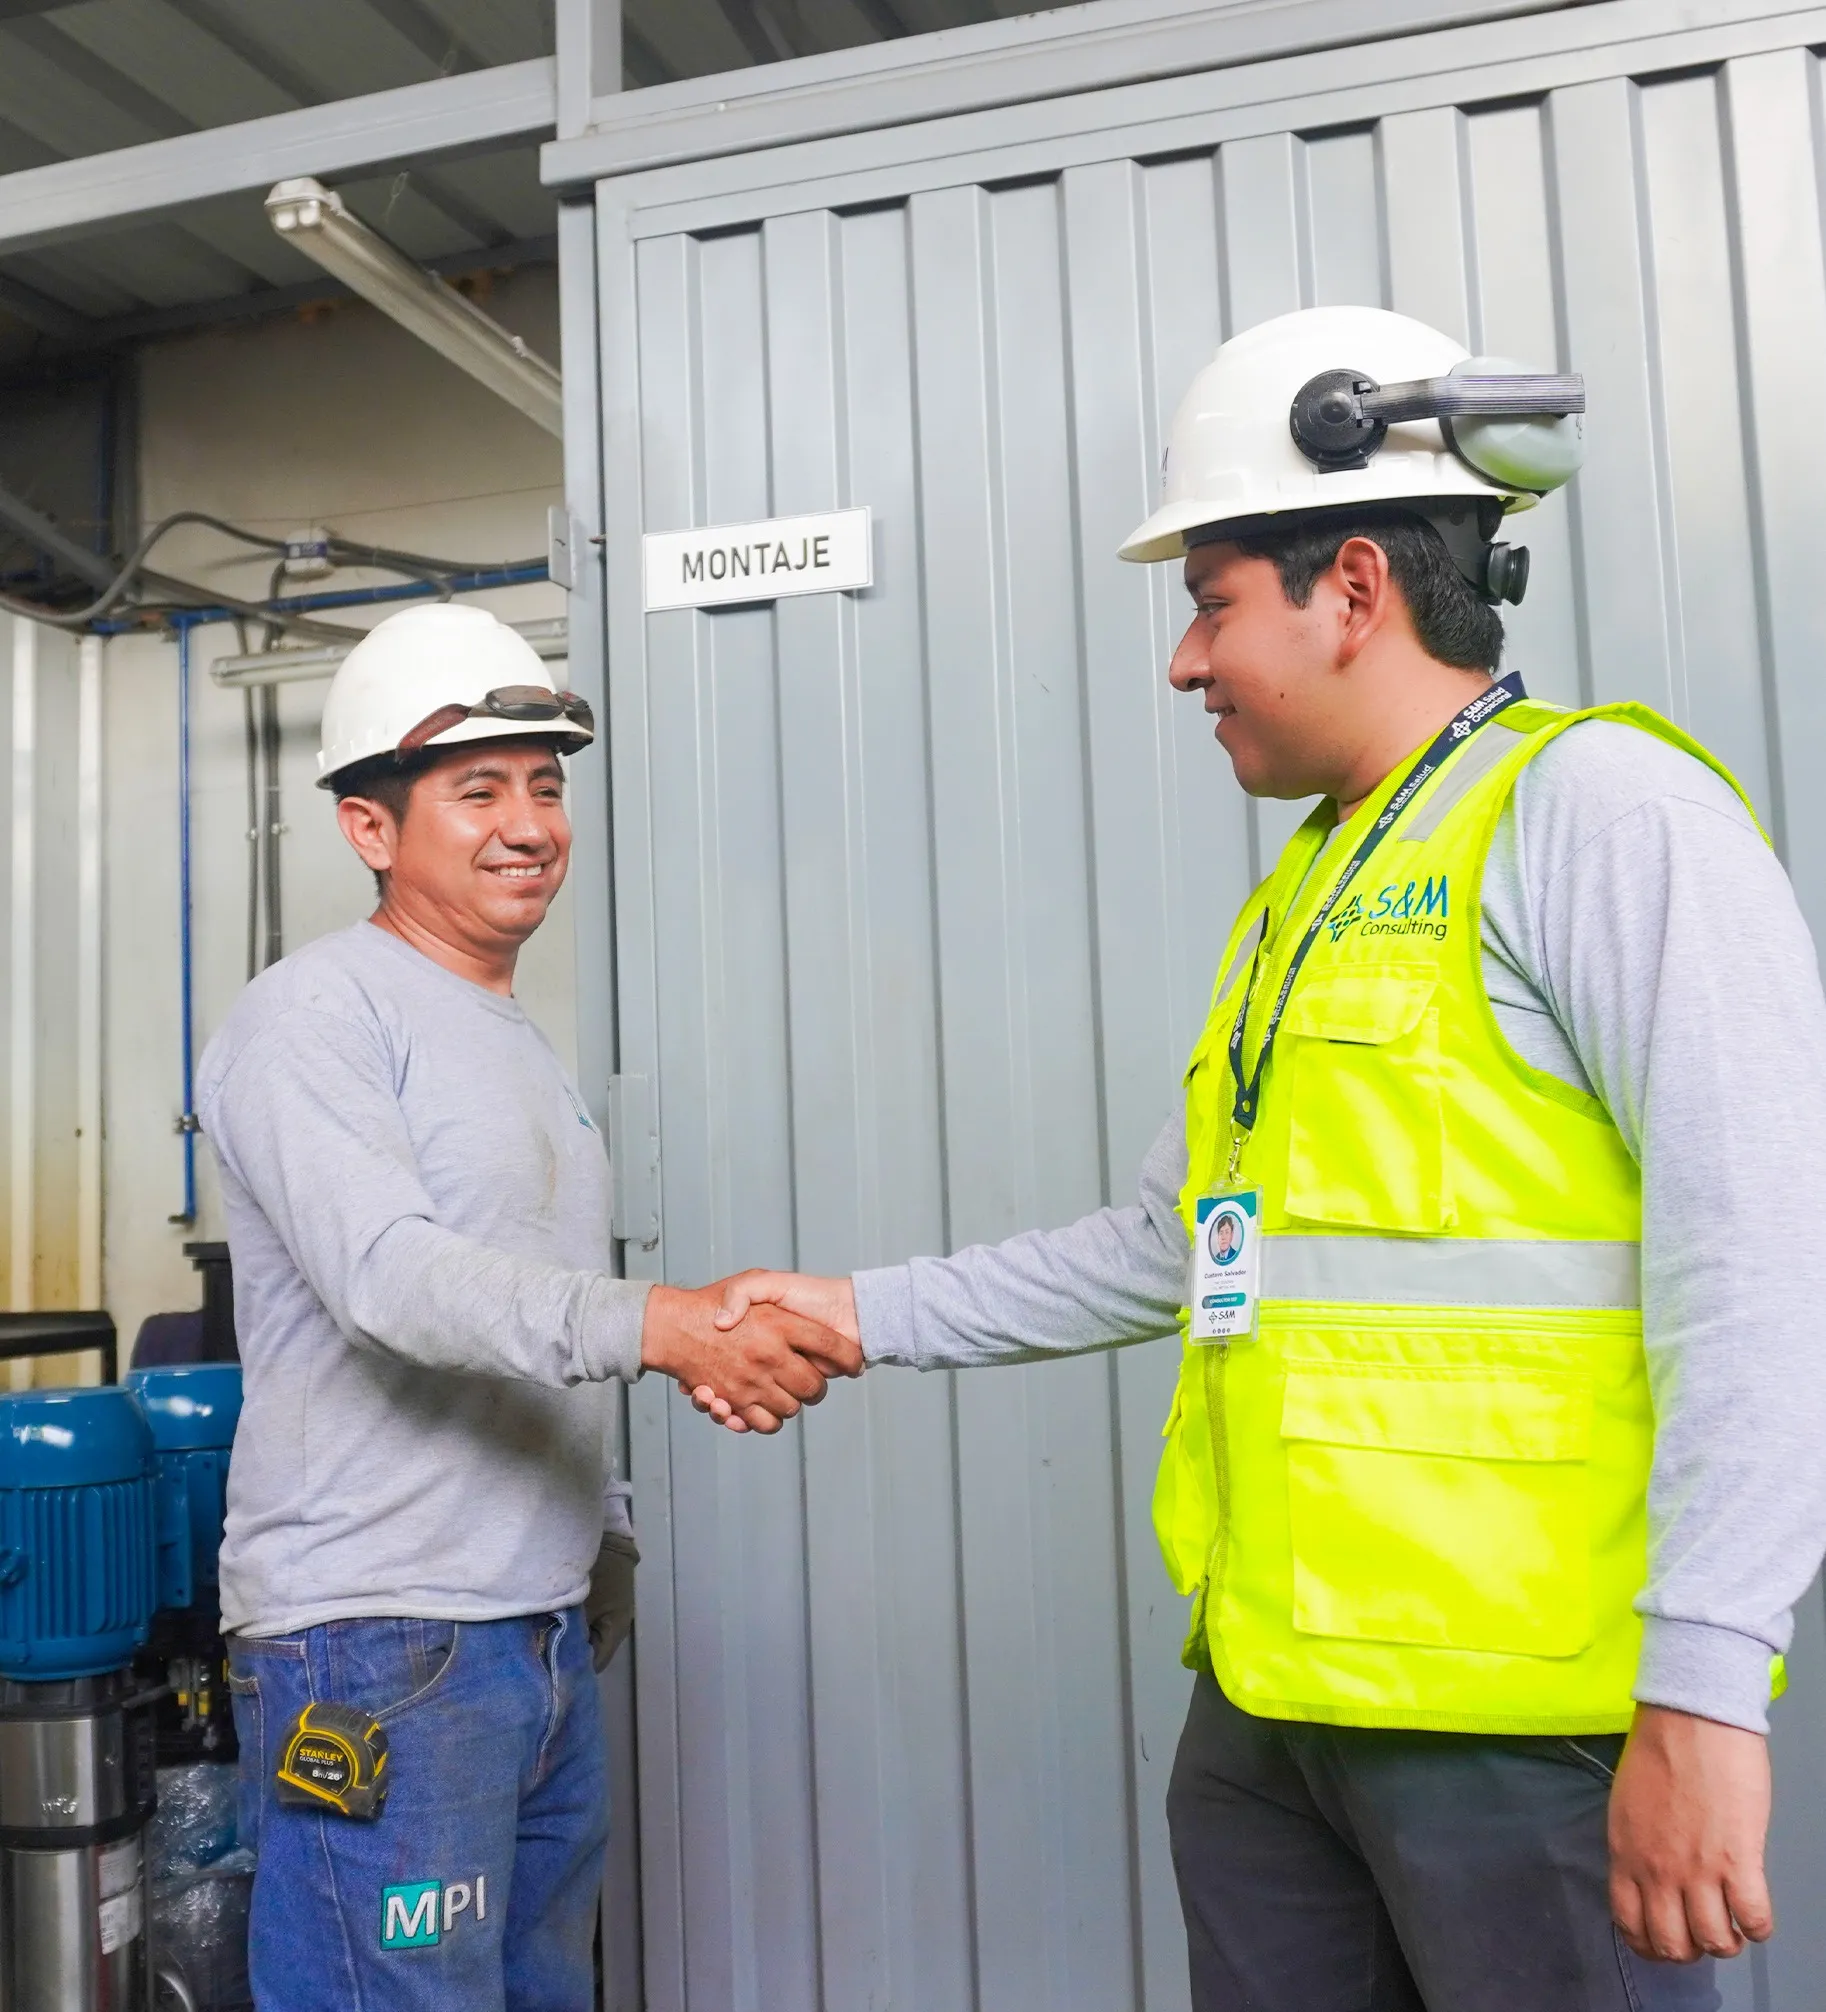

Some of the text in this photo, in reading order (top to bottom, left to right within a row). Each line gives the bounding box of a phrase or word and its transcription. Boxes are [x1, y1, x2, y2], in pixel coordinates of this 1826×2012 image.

[682, 535, 830, 583] MONTAJE
[1463, 686, 1506, 719] S&M Salud
[1409, 763, 1432, 788] Salud
[1368, 874, 1448, 920] S&M
[1360, 918, 1448, 941] Consulting
[1218, 1310, 1236, 1320] S&M
[300, 1748, 343, 1762] STANLEY
[385, 1875, 486, 1940] MPI
